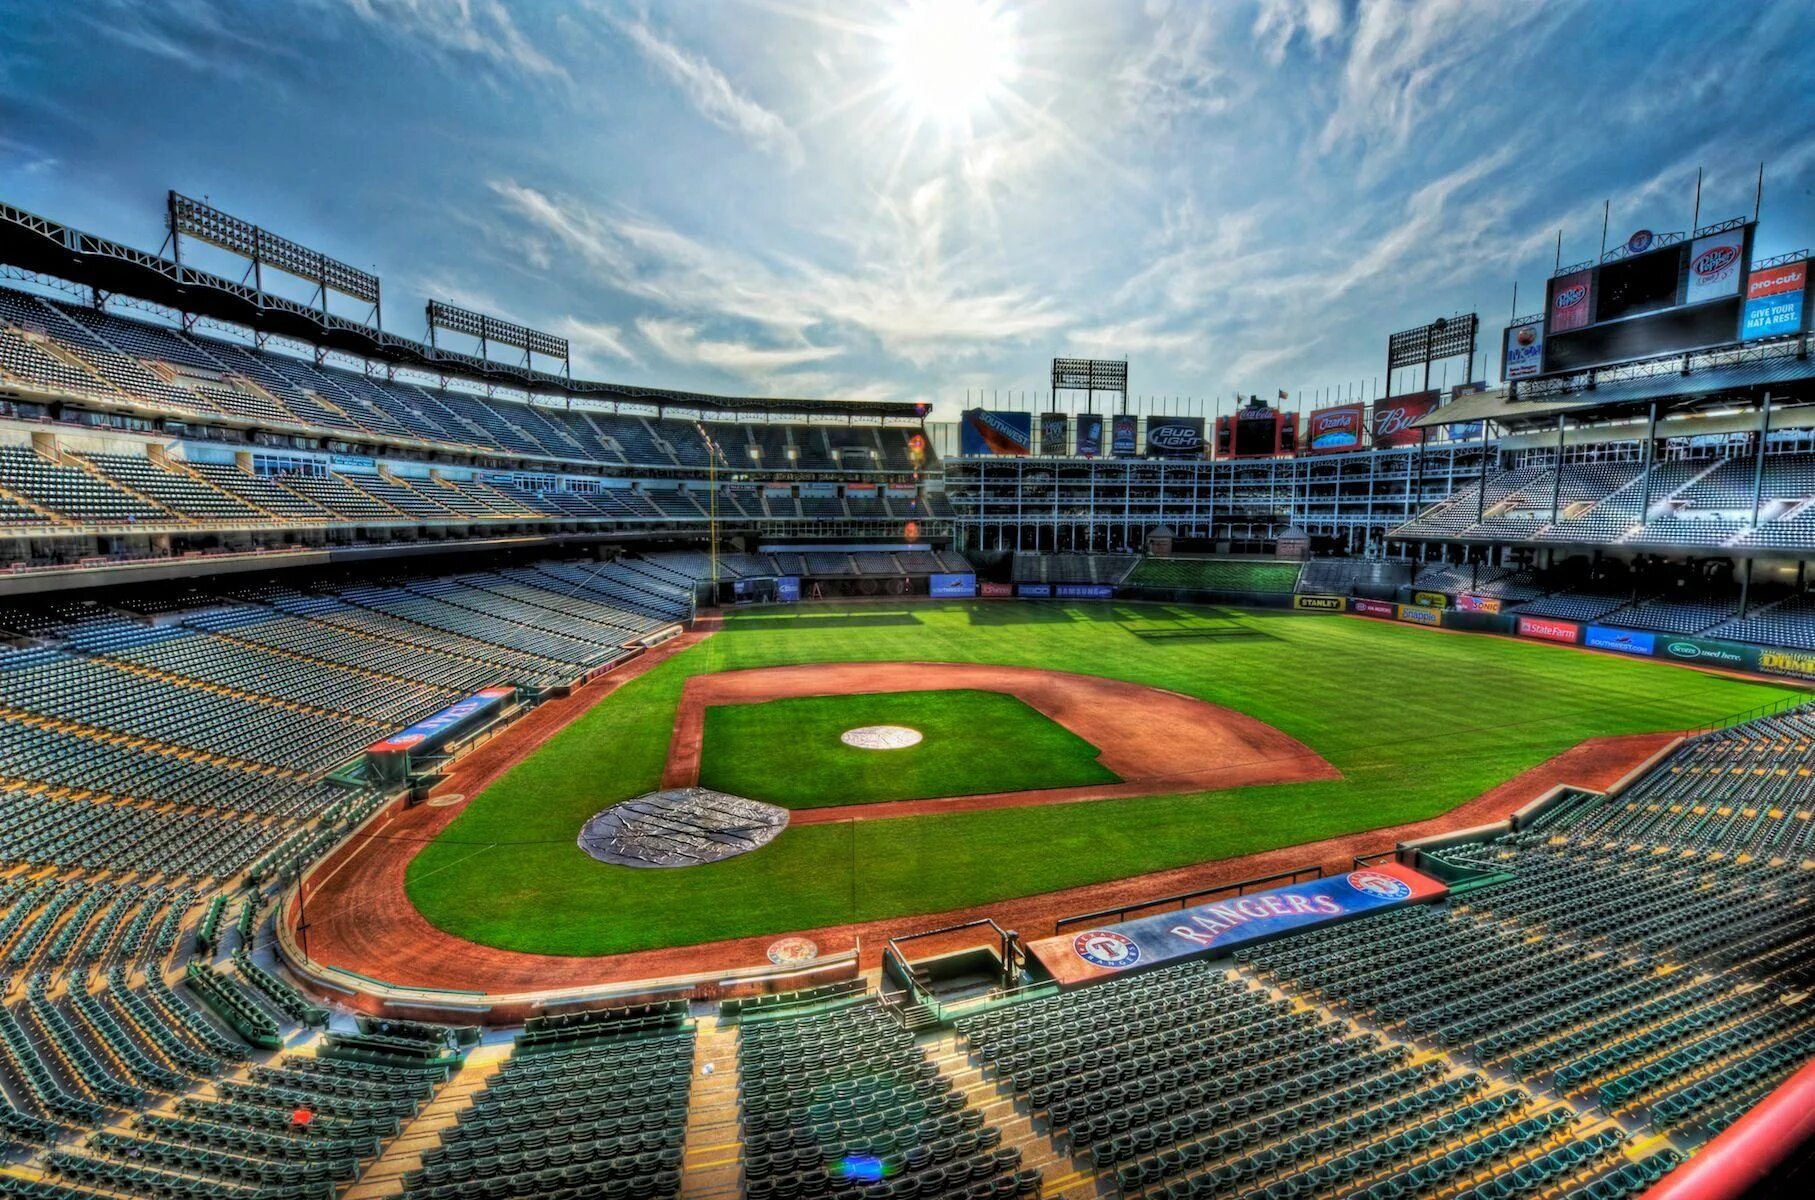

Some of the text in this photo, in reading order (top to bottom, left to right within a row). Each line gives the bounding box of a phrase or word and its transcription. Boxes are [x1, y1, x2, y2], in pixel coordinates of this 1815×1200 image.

[1751, 303, 1794, 319] GIVE YOUR
[1747, 312, 1798, 328] HAT A REST.
[979, 411, 1029, 448] SOUTHWEST
[1320, 416, 1351, 430] Ozarka
[1160, 428, 1196, 437] BUD
[1152, 436, 1201, 446] LIGHT
[1057, 587, 1099, 595] SAMSUNG
[1301, 599, 1338, 608] STANLEY
[1473, 603, 1497, 611] SONIC
[1403, 608, 1436, 621] Snapple
[1530, 625, 1574, 638] State Farm
[1170, 893, 1341, 945] RANGERS
[1087, 944, 1137, 966] RANGERS
[1091, 940, 1120, 958] T
